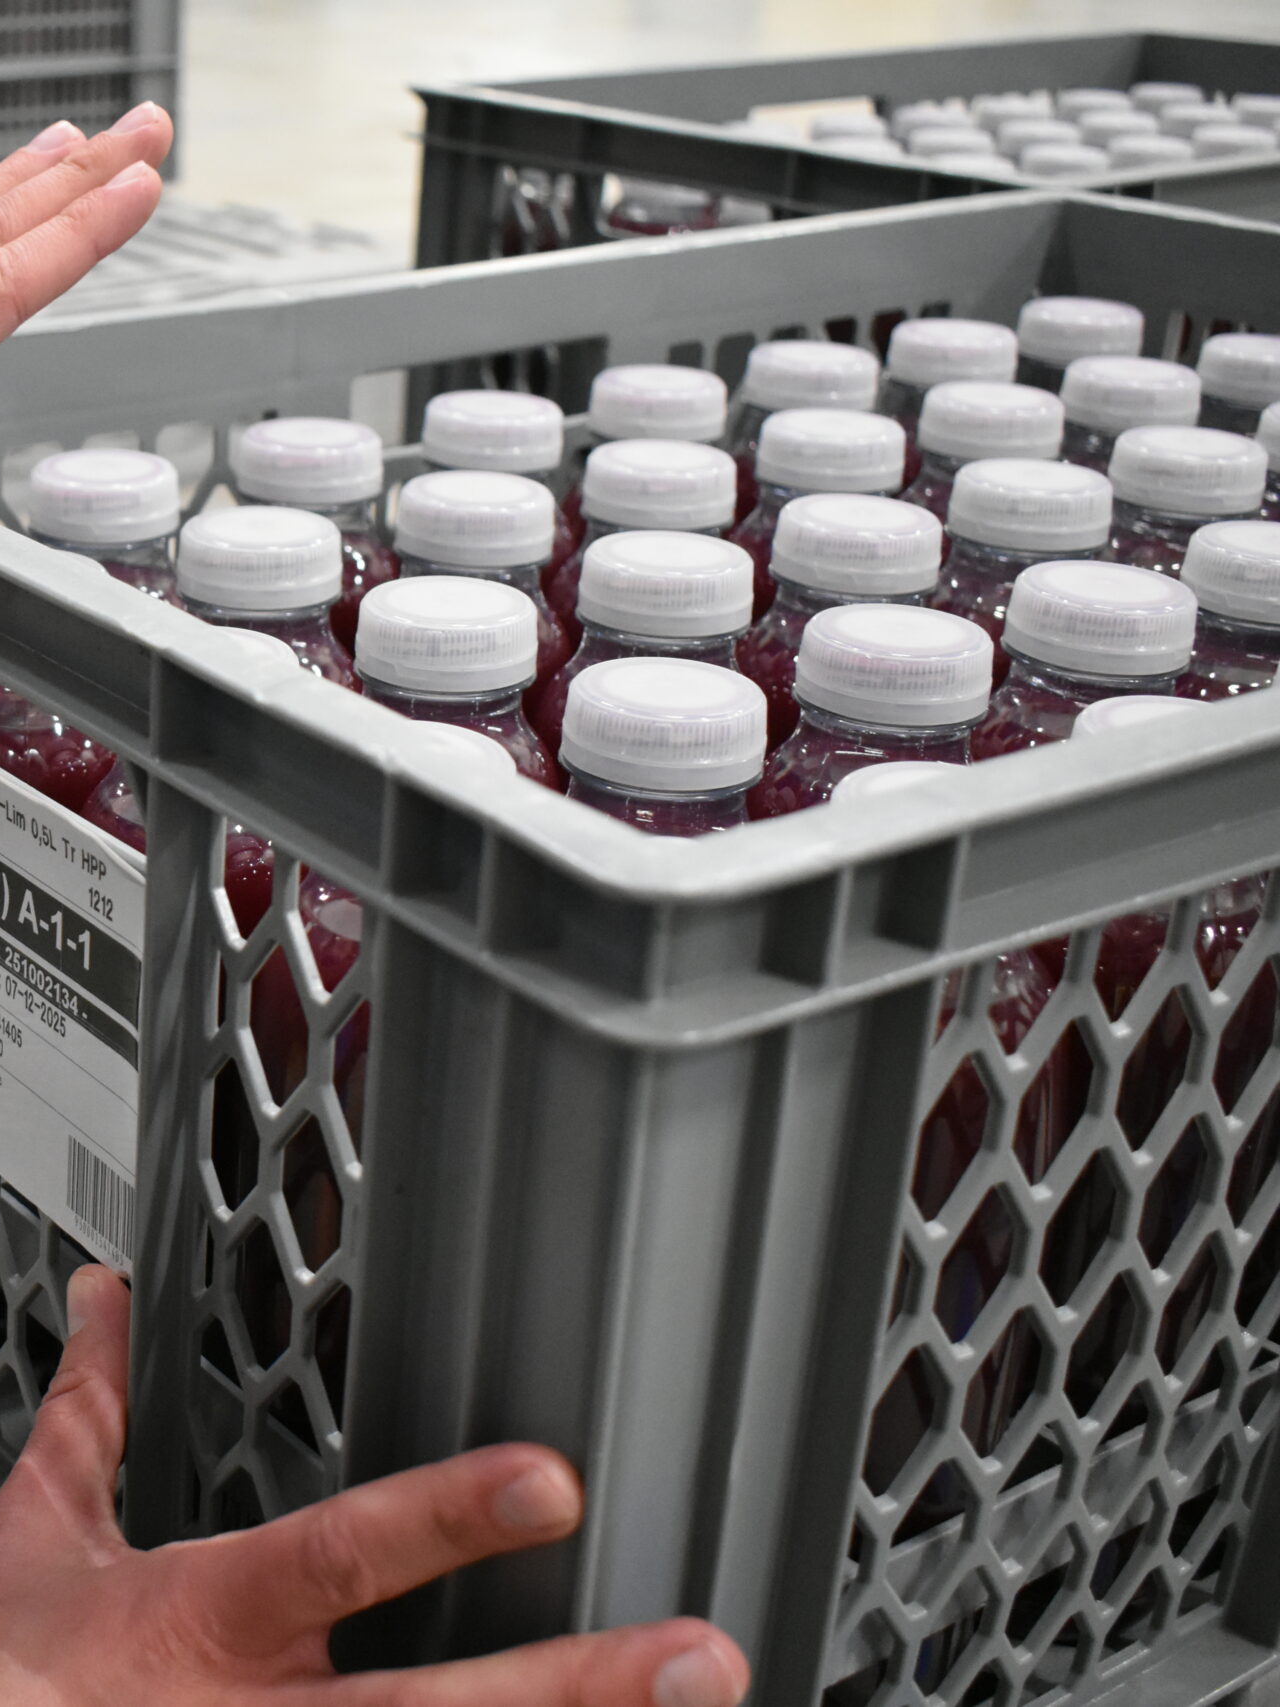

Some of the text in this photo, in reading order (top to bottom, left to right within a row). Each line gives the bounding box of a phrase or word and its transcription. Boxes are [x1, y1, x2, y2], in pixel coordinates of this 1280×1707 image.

[31, 817, 57, 852] 0,5L
[62, 837, 76, 863] Tr
[81, 850, 107, 881] HPP
[18, 888, 92, 971] A-1-1
[88, 887, 114, 922] 1212
[4, 945, 79, 1017] 251002134
[5, 975, 67, 1038] 07-12-2025
